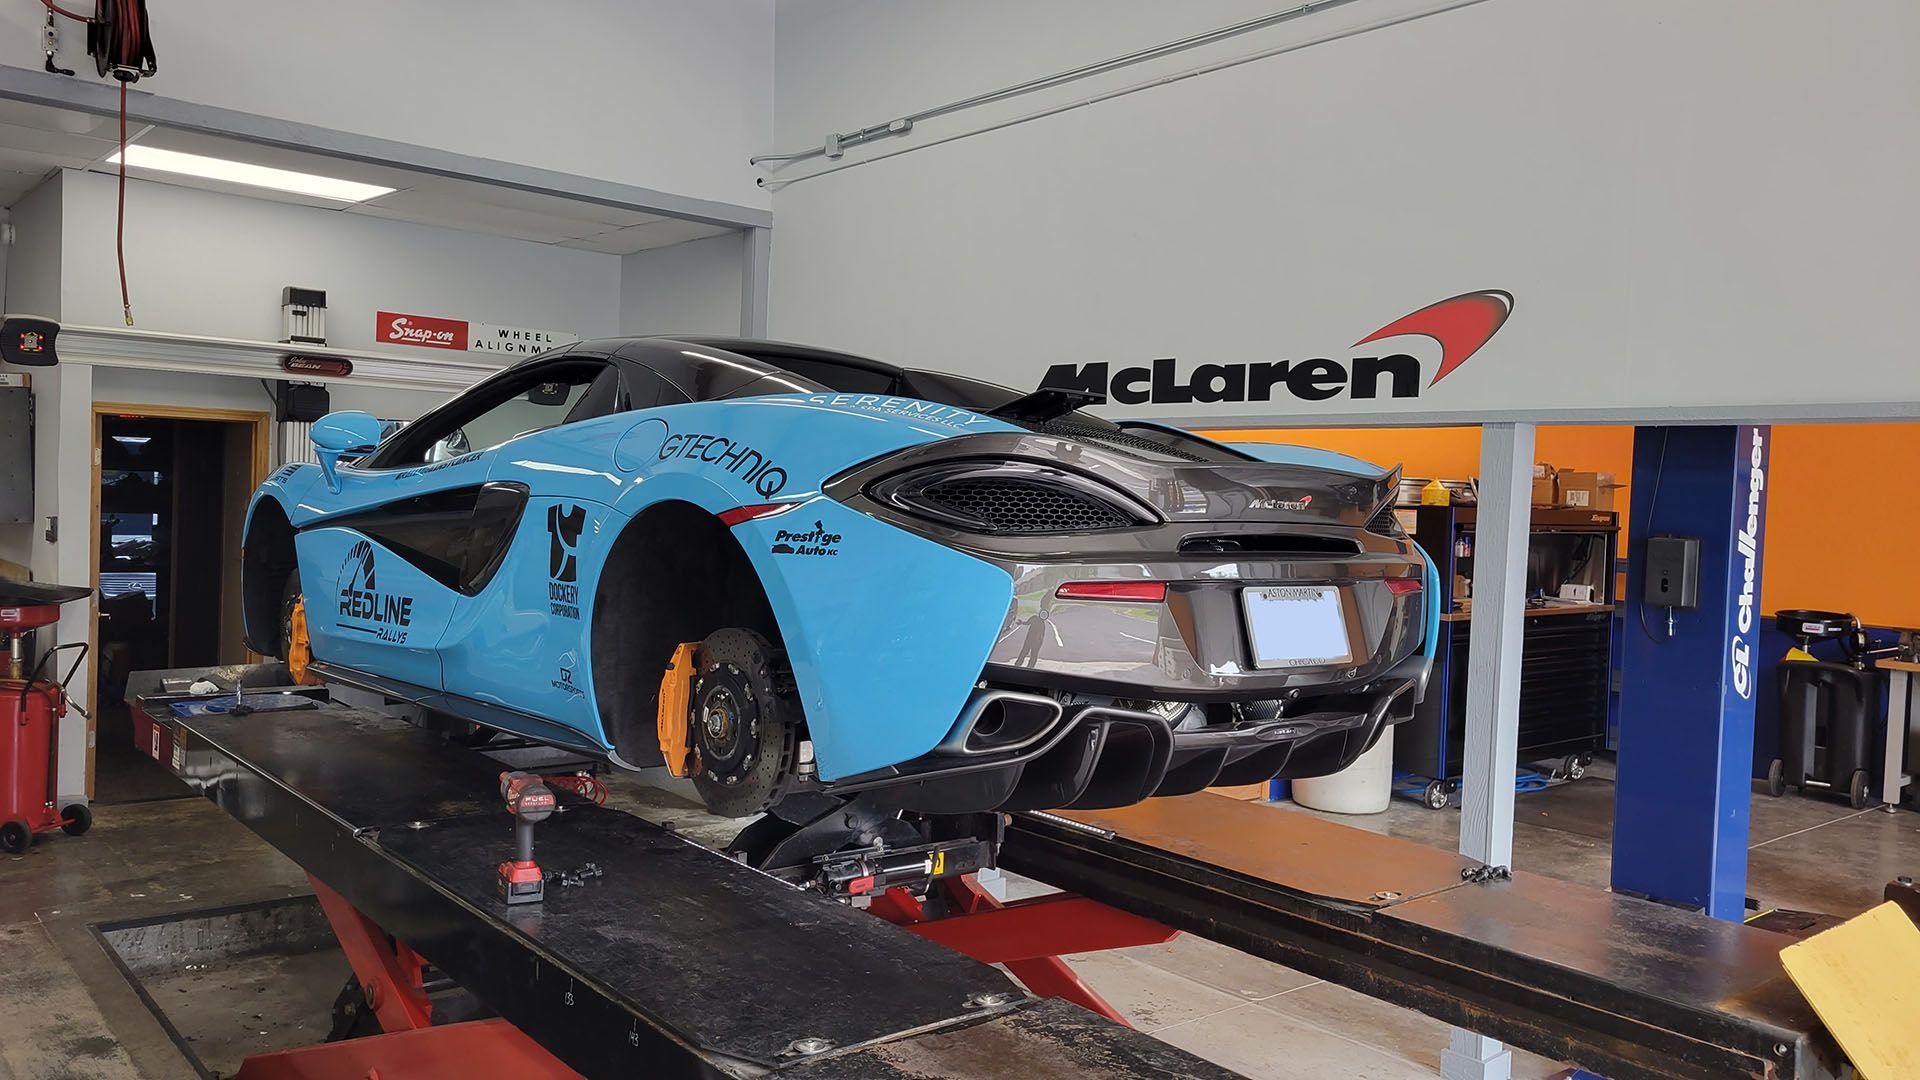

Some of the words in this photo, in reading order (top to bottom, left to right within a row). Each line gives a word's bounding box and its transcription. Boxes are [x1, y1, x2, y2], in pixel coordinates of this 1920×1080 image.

[389, 317, 455, 342] Snap-on
[498, 329, 552, 343] WHEEL
[1036, 353, 1421, 405] McLaren
[808, 394, 990, 425] SERENITY
[884, 407, 942, 423] SERVICES
[940, 418, 965, 429] LLC
[658, 434, 788, 500] GTECHNIQ
[775, 521, 842, 546] Prestige
[1737, 427, 1764, 634] Challenger
[795, 545, 827, 556] Auto
[549, 582, 579, 605] DOCKERY
[1268, 588, 1292, 598] ASTON
[340, 589, 414, 627] REDLINE
[376, 627, 408, 644] RALLYS
